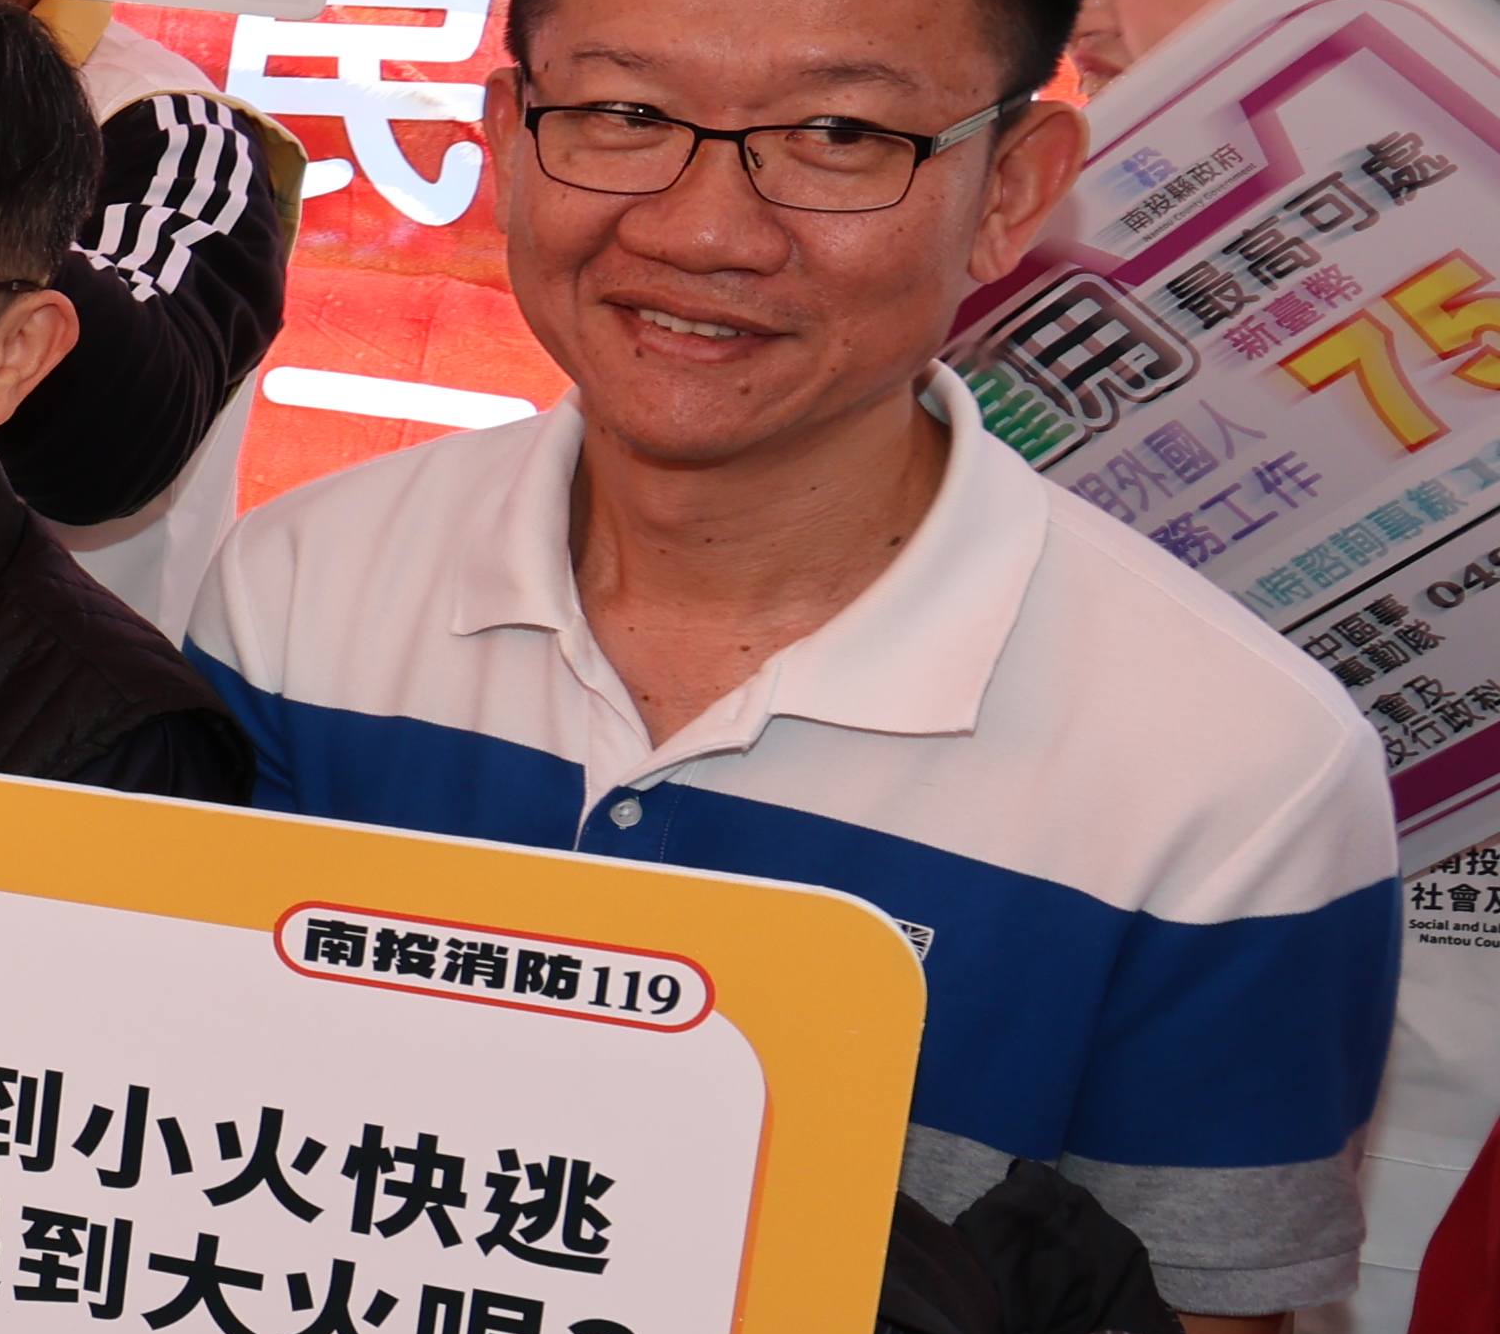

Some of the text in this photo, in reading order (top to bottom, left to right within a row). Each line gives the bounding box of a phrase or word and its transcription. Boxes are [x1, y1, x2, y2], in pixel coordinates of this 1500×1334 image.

[1120, 142, 1246, 235] 南投縣政府
[1164, 129, 1460, 332] 最高可處
[1220, 262, 1364, 362] 新臺幣
[301, 917, 684, 1017] 南投消防119
[1408, 918, 1479, 932] Social and
[1418, 934, 1471, 947] Nantou
